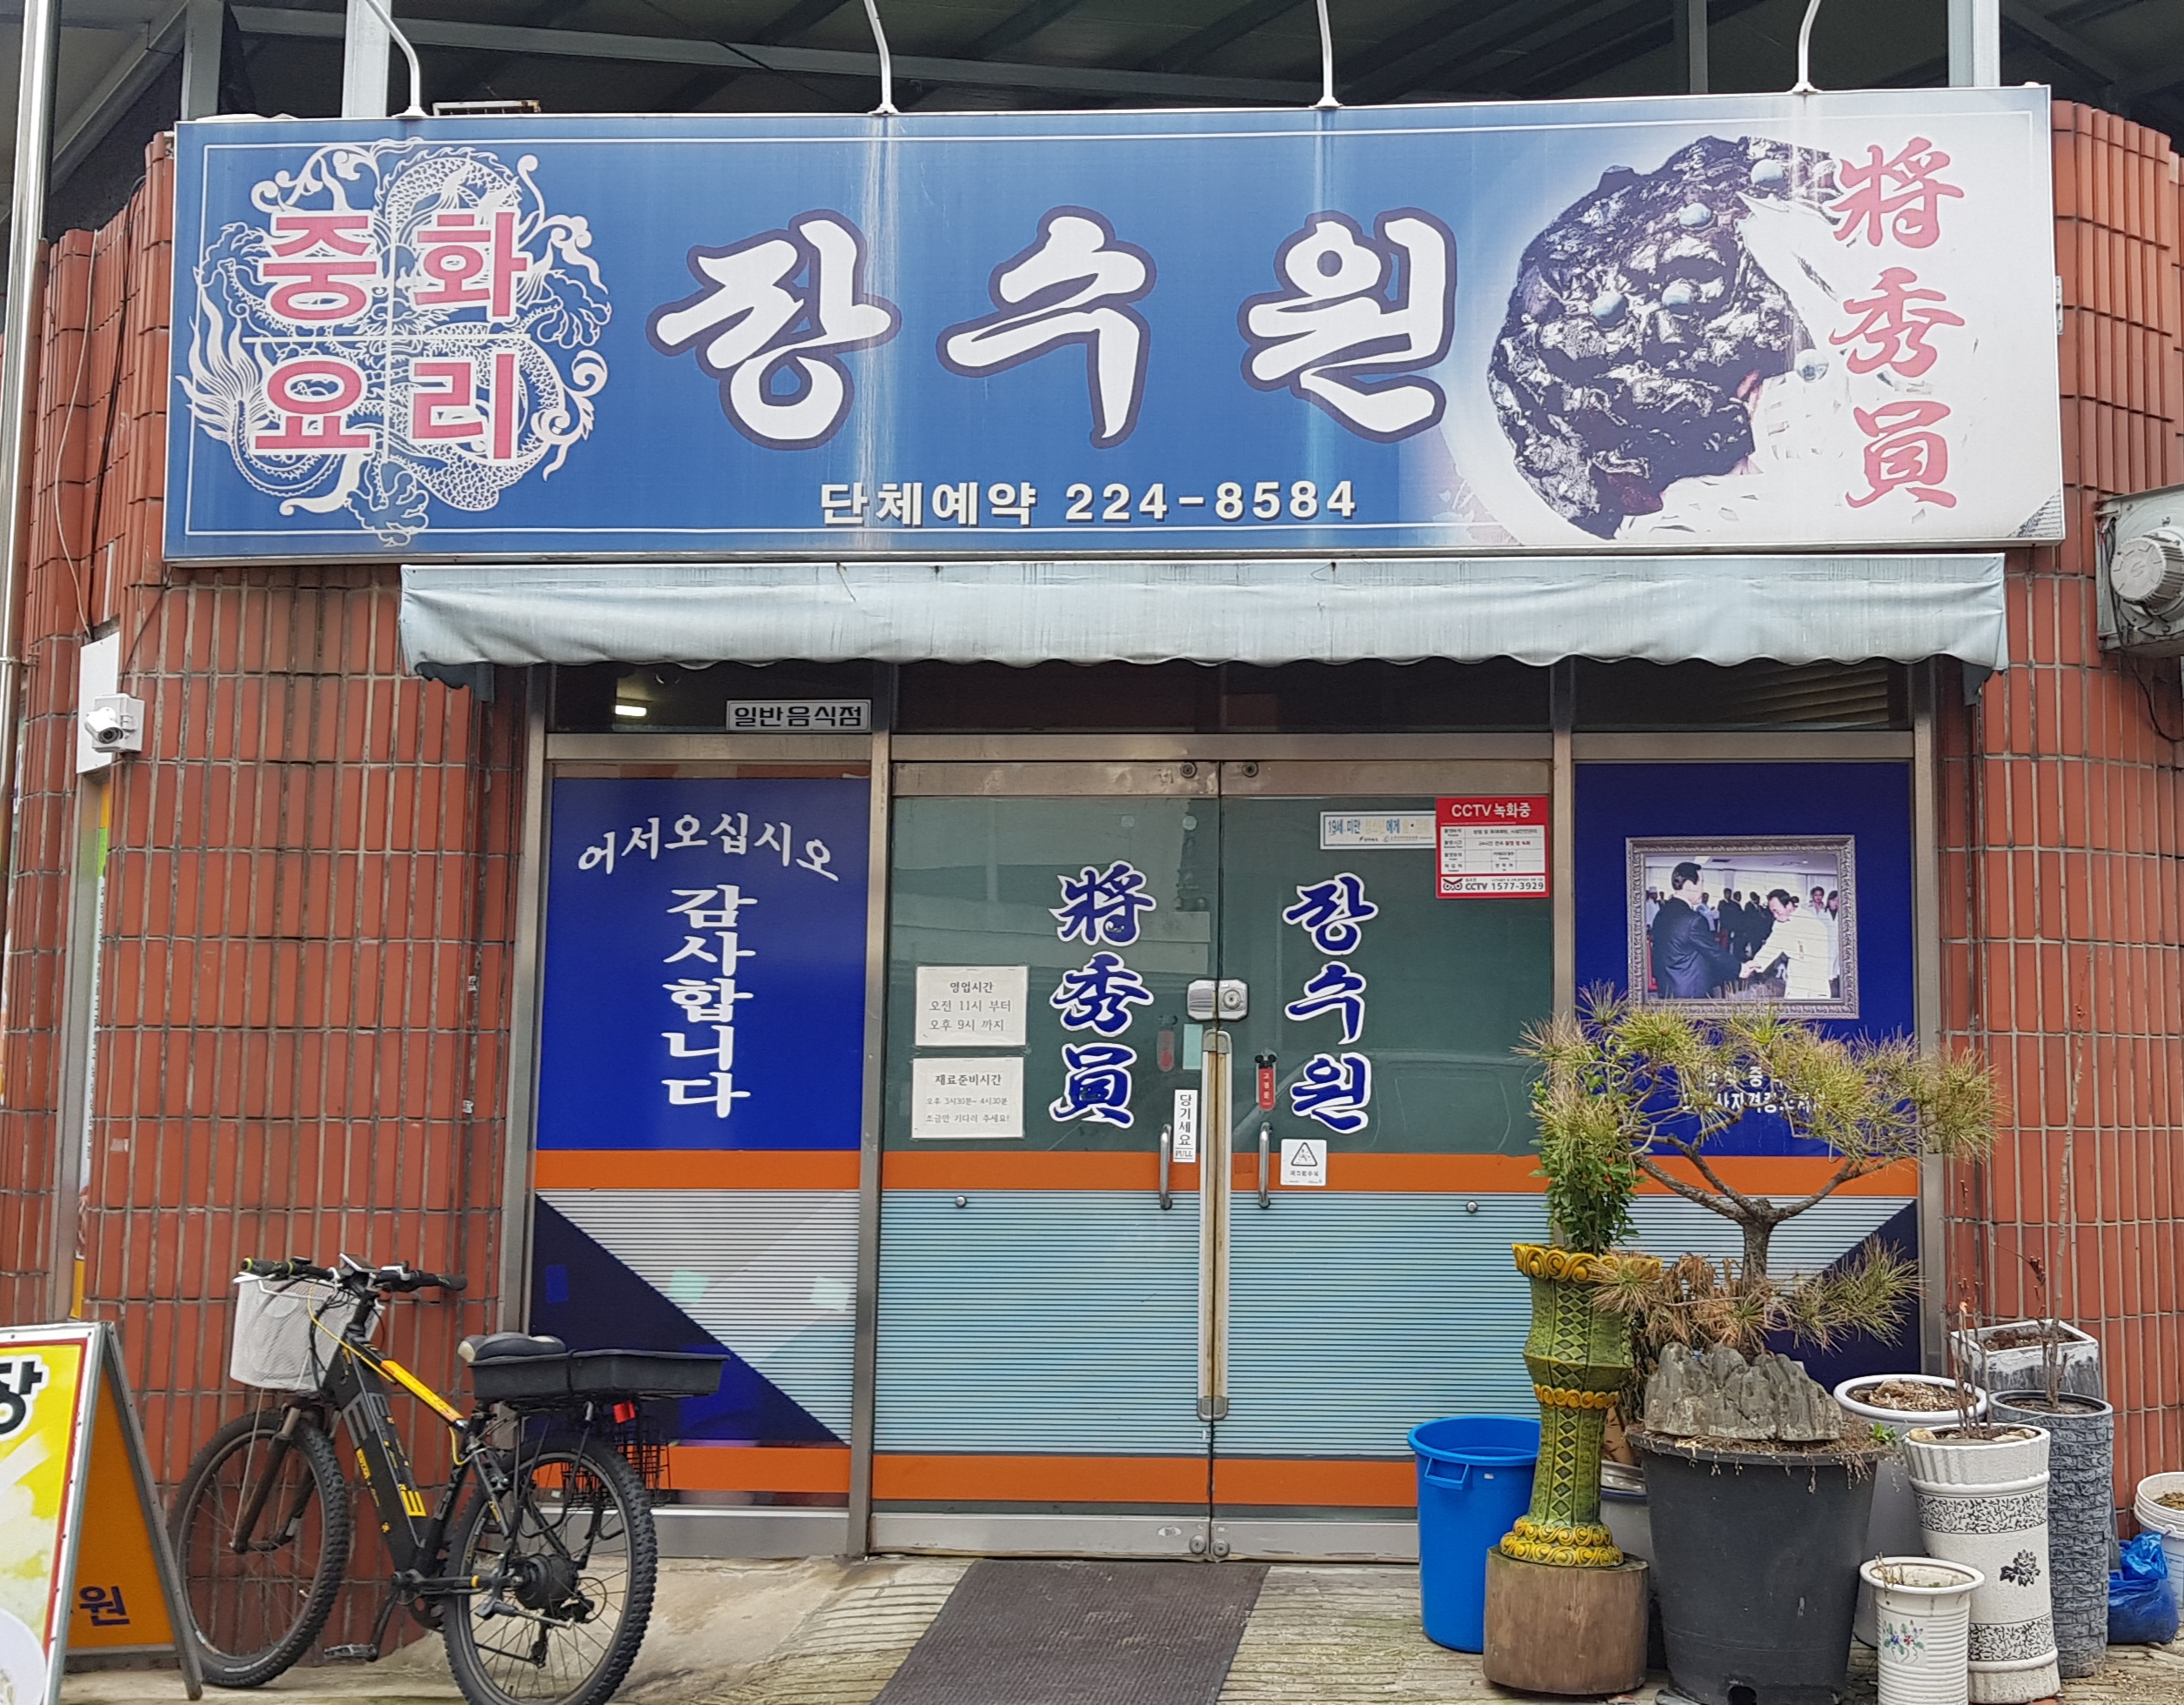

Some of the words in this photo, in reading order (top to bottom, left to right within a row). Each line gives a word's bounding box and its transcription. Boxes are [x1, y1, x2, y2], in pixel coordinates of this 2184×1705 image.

[262, 211, 527, 320] 중화
[647, 207, 1456, 448] 장수원
[255, 353, 516, 459] 요리
[821, 482, 1037, 526] 단체예약
[1065, 480, 1357, 522] 224-8584
[734, 705, 861, 727] 일반음식점
[1451, 804, 1492, 817] CCTV
[1494, 802, 1531, 818] 녹화중
[578, 812, 839, 881] 어서오십시오
[1491, 882, 1544, 891] 1577-3929
[661, 885, 758, 1118] 감사합니다
[929, 1000, 952, 1013] 오전
[960, 1000, 982, 1012] 11시
[988, 1000, 1011, 1013] 부터
[950, 981, 995, 993] 영업시간
[1283, 873, 1378, 1133] 장수원
[929, 1020, 952, 1031] 오후
[958, 1020, 975, 1031] 9시
[981, 1020, 1004, 1031] 까지
[935, 1074, 1002, 1086] 재료준비시간
[1179, 1094, 1192, 1146] 당기세요
